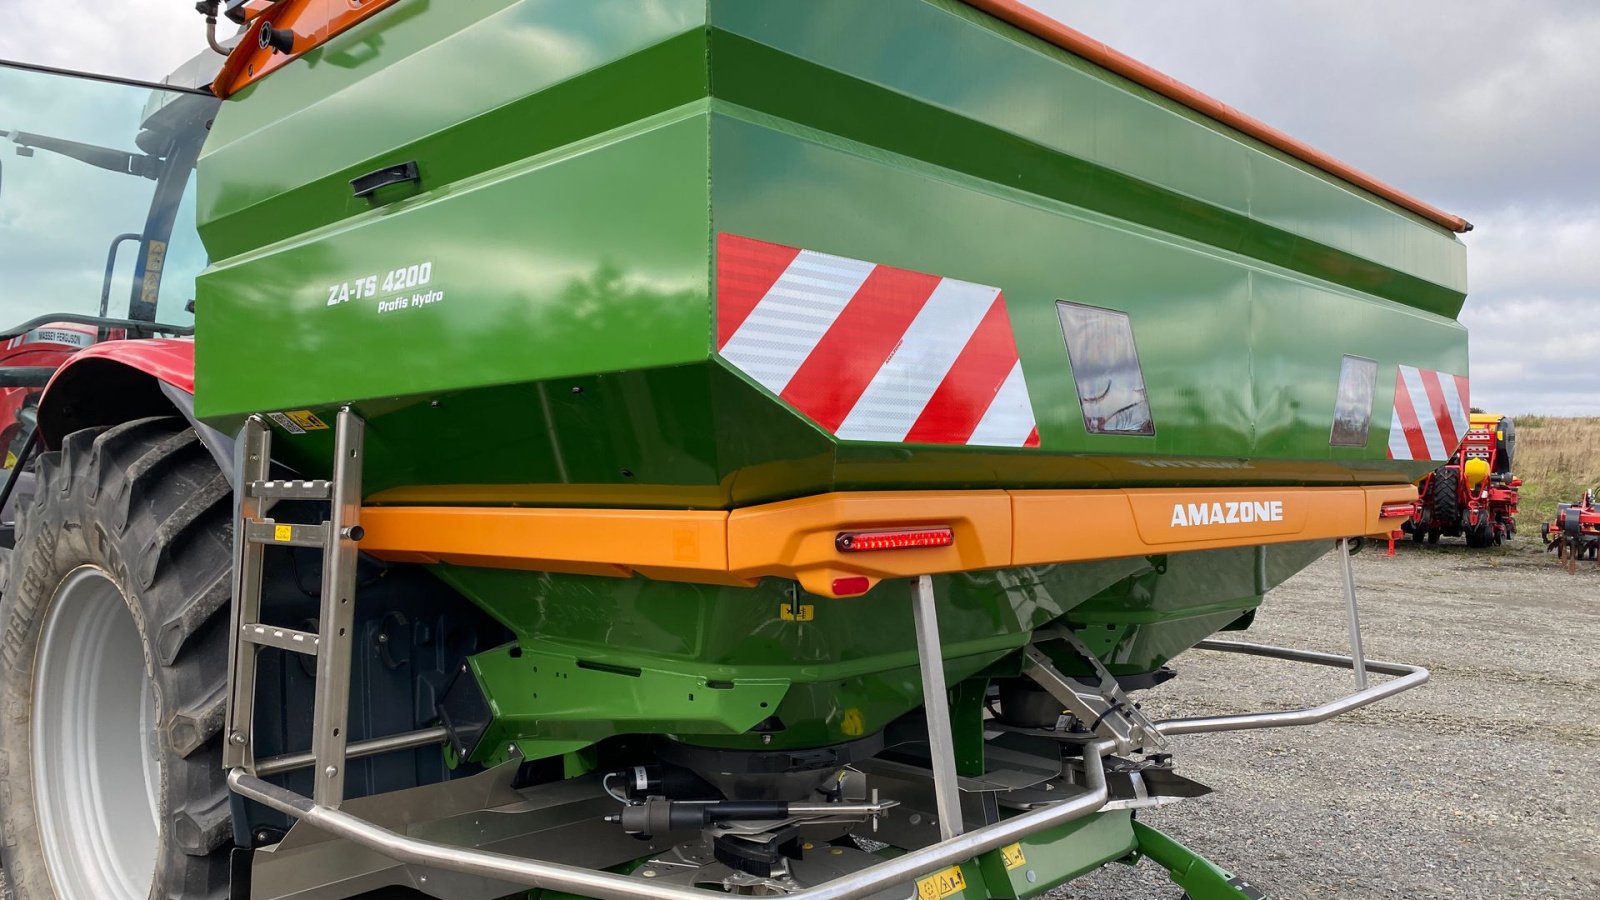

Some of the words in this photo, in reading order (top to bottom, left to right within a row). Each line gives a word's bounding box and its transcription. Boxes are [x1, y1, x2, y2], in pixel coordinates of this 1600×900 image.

[327, 275, 377, 306] ZA-TS
[382, 262, 432, 292] 4200
[378, 299, 408, 313] Profis
[411, 290, 443, 308] Hydro
[1171, 501, 1283, 527] AMAZONE
